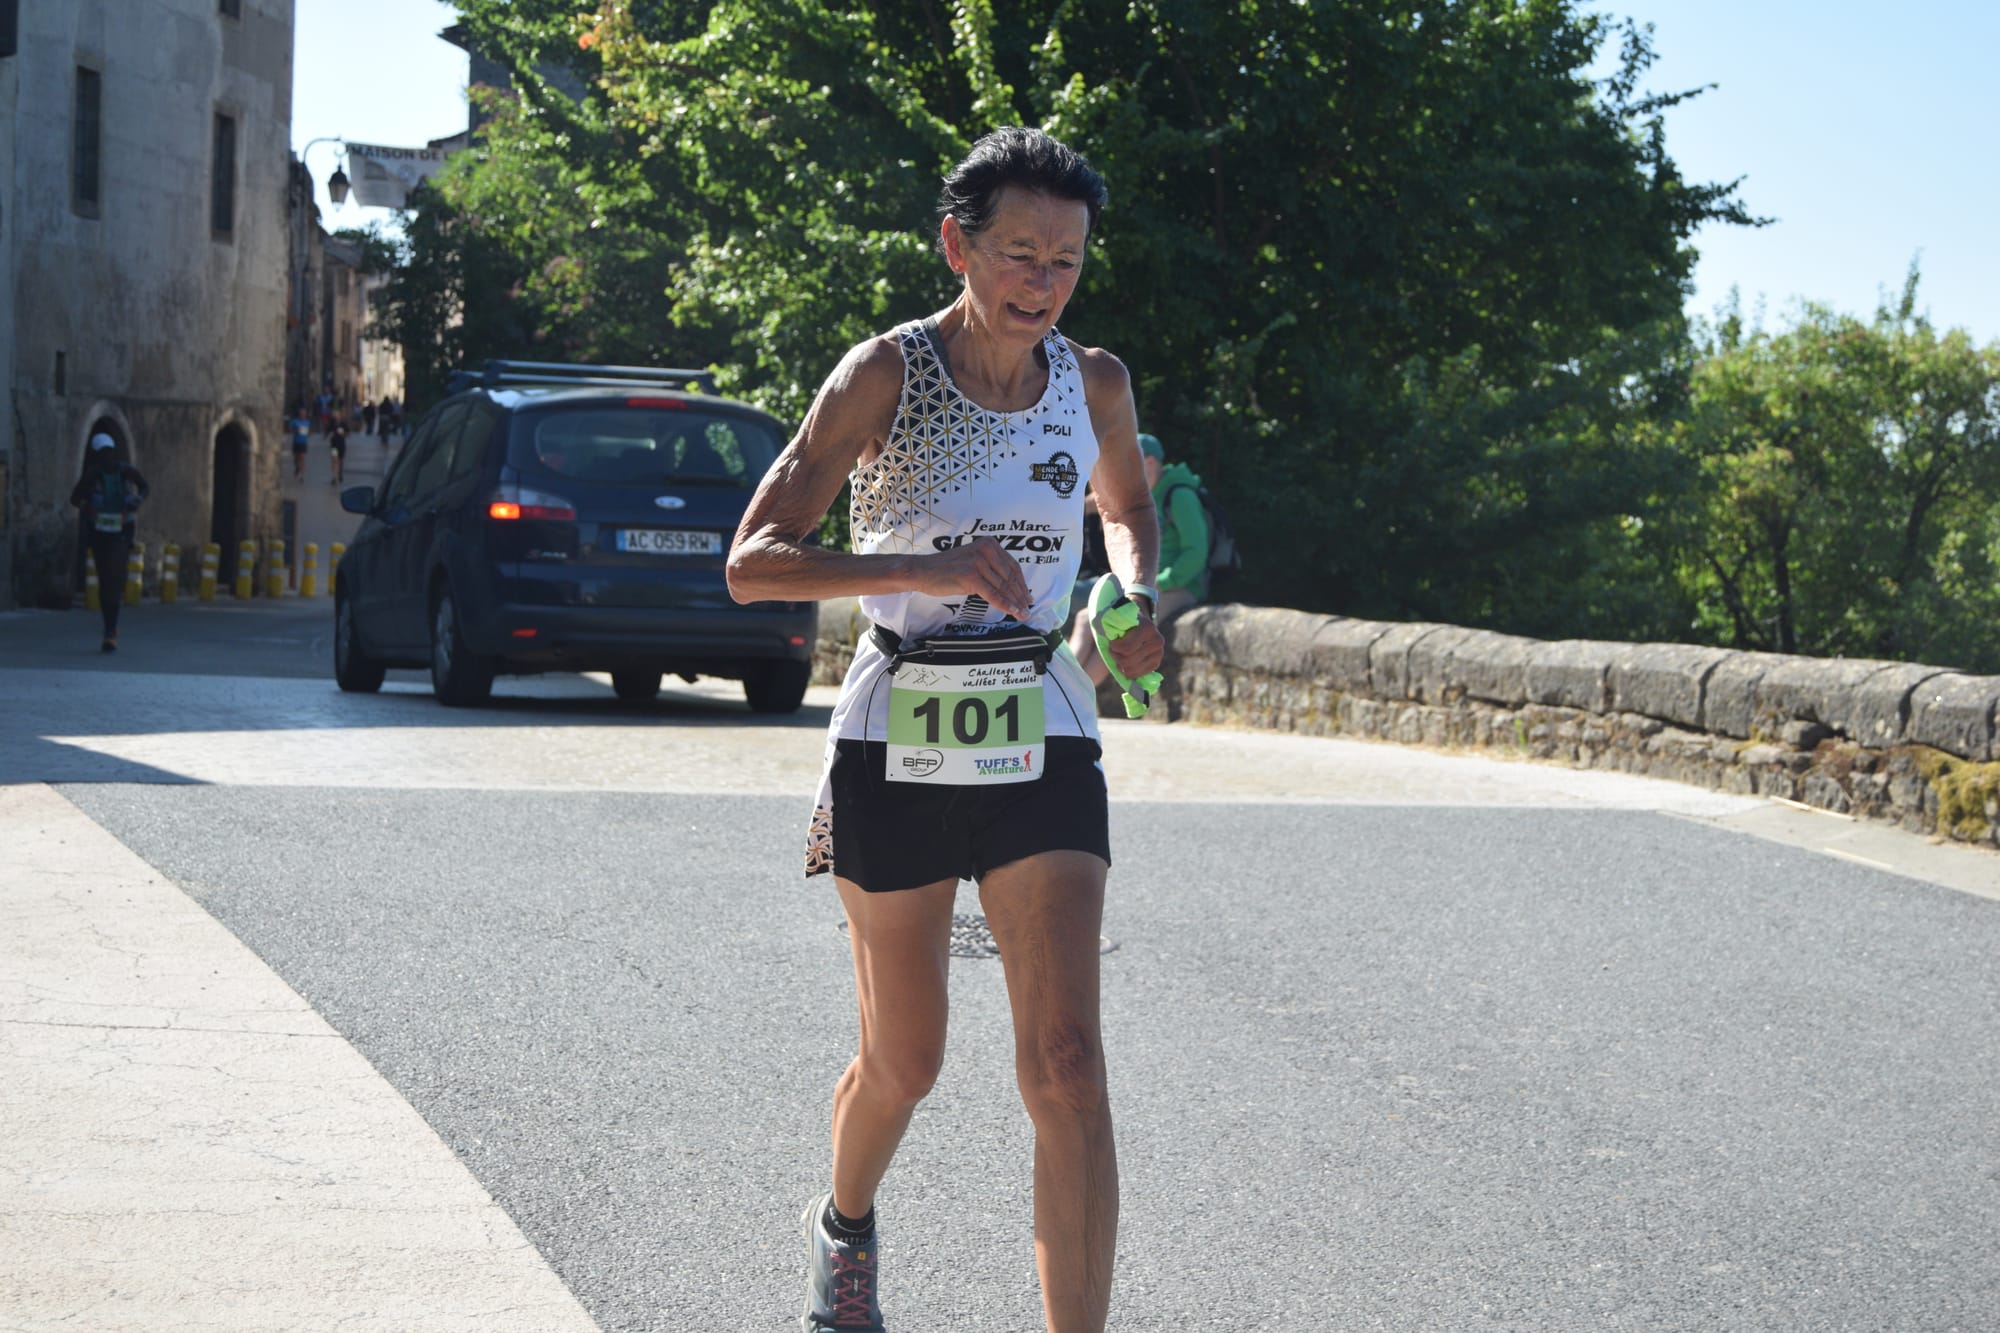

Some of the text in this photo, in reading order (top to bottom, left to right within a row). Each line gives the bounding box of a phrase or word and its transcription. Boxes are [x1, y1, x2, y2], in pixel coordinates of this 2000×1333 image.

[420, 150, 439, 160] DE
[1043, 424, 1071, 436] POLI
[963, 518, 1051, 535] Jean Marc
[628, 532, 648, 549] AC
[654, 532, 685, 550] 059
[1018, 555, 1031, 563] et
[968, 665, 1032, 677] Challenge des
[962, 674, 1037, 687] vallées cévenoles
[913, 694, 1019, 745] 101
[902, 756, 938, 769] BFP
[974, 757, 1020, 769] TUFF'S
[978, 765, 1024, 776] Aventure
